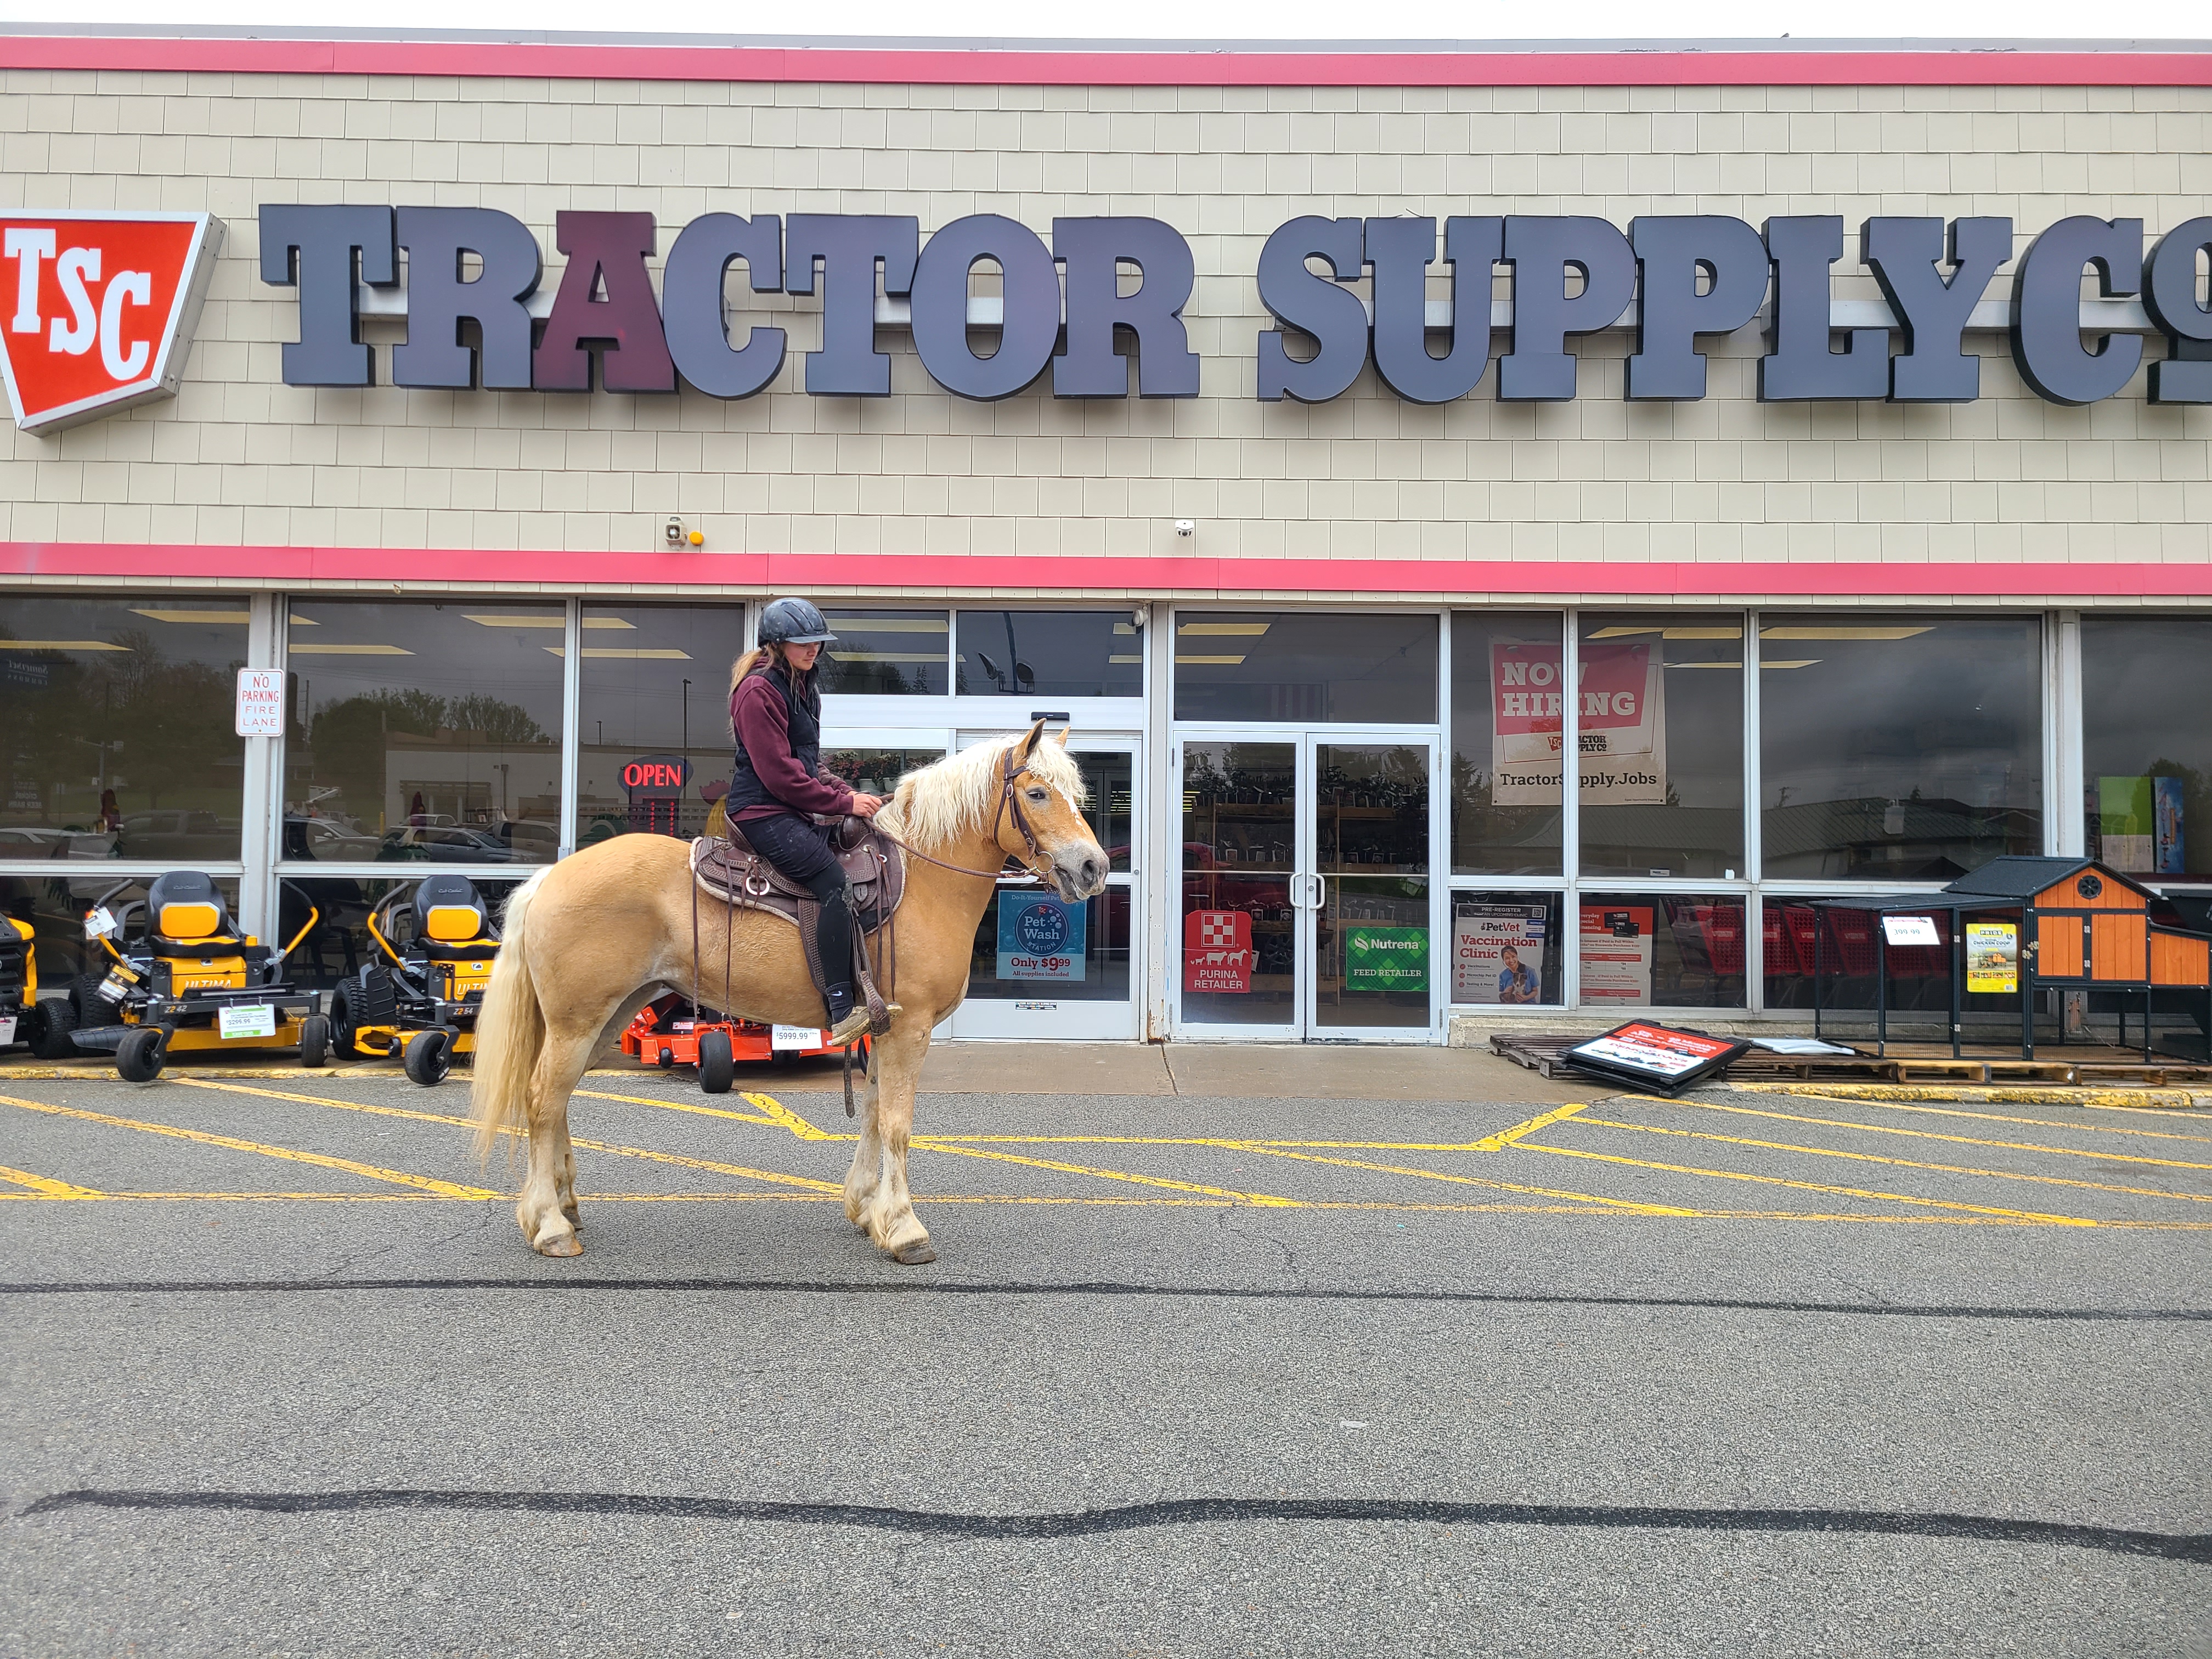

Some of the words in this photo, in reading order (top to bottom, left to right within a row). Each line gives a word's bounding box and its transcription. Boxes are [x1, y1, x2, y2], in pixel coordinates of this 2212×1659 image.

[4, 228, 151, 381] TSC
[258, 204, 1200, 401] TRACTOR
[1257, 214, 2013, 404] SUPPLY
[253, 676, 269, 689] NO
[242, 690, 279, 702] PARKING
[245, 706, 275, 714] FIRE
[243, 718, 277, 726] LANE
[1549, 737, 1562, 749] TSC
[624, 764, 681, 786] OPEN
[1500, 771, 1657, 788] Tractorpply.Jobs
[1024, 916, 1046, 927] Pet
[1486, 922, 1520, 932] PetVet
[1023, 928, 1060, 940] Wash
[1026, 941, 1057, 952] STATION
[1371, 939, 1419, 950] Nutrena
[1460, 934, 1538, 947] Vaccination
[1459, 948, 1498, 958] Clinic
[1011, 957, 1039, 969] Only
[1199, 969, 1238, 979] PURINA
[1378, 969, 1422, 977] RETAILER
[457, 983, 488, 995] ULTI
[1194, 979, 1243, 989] RETAILER
